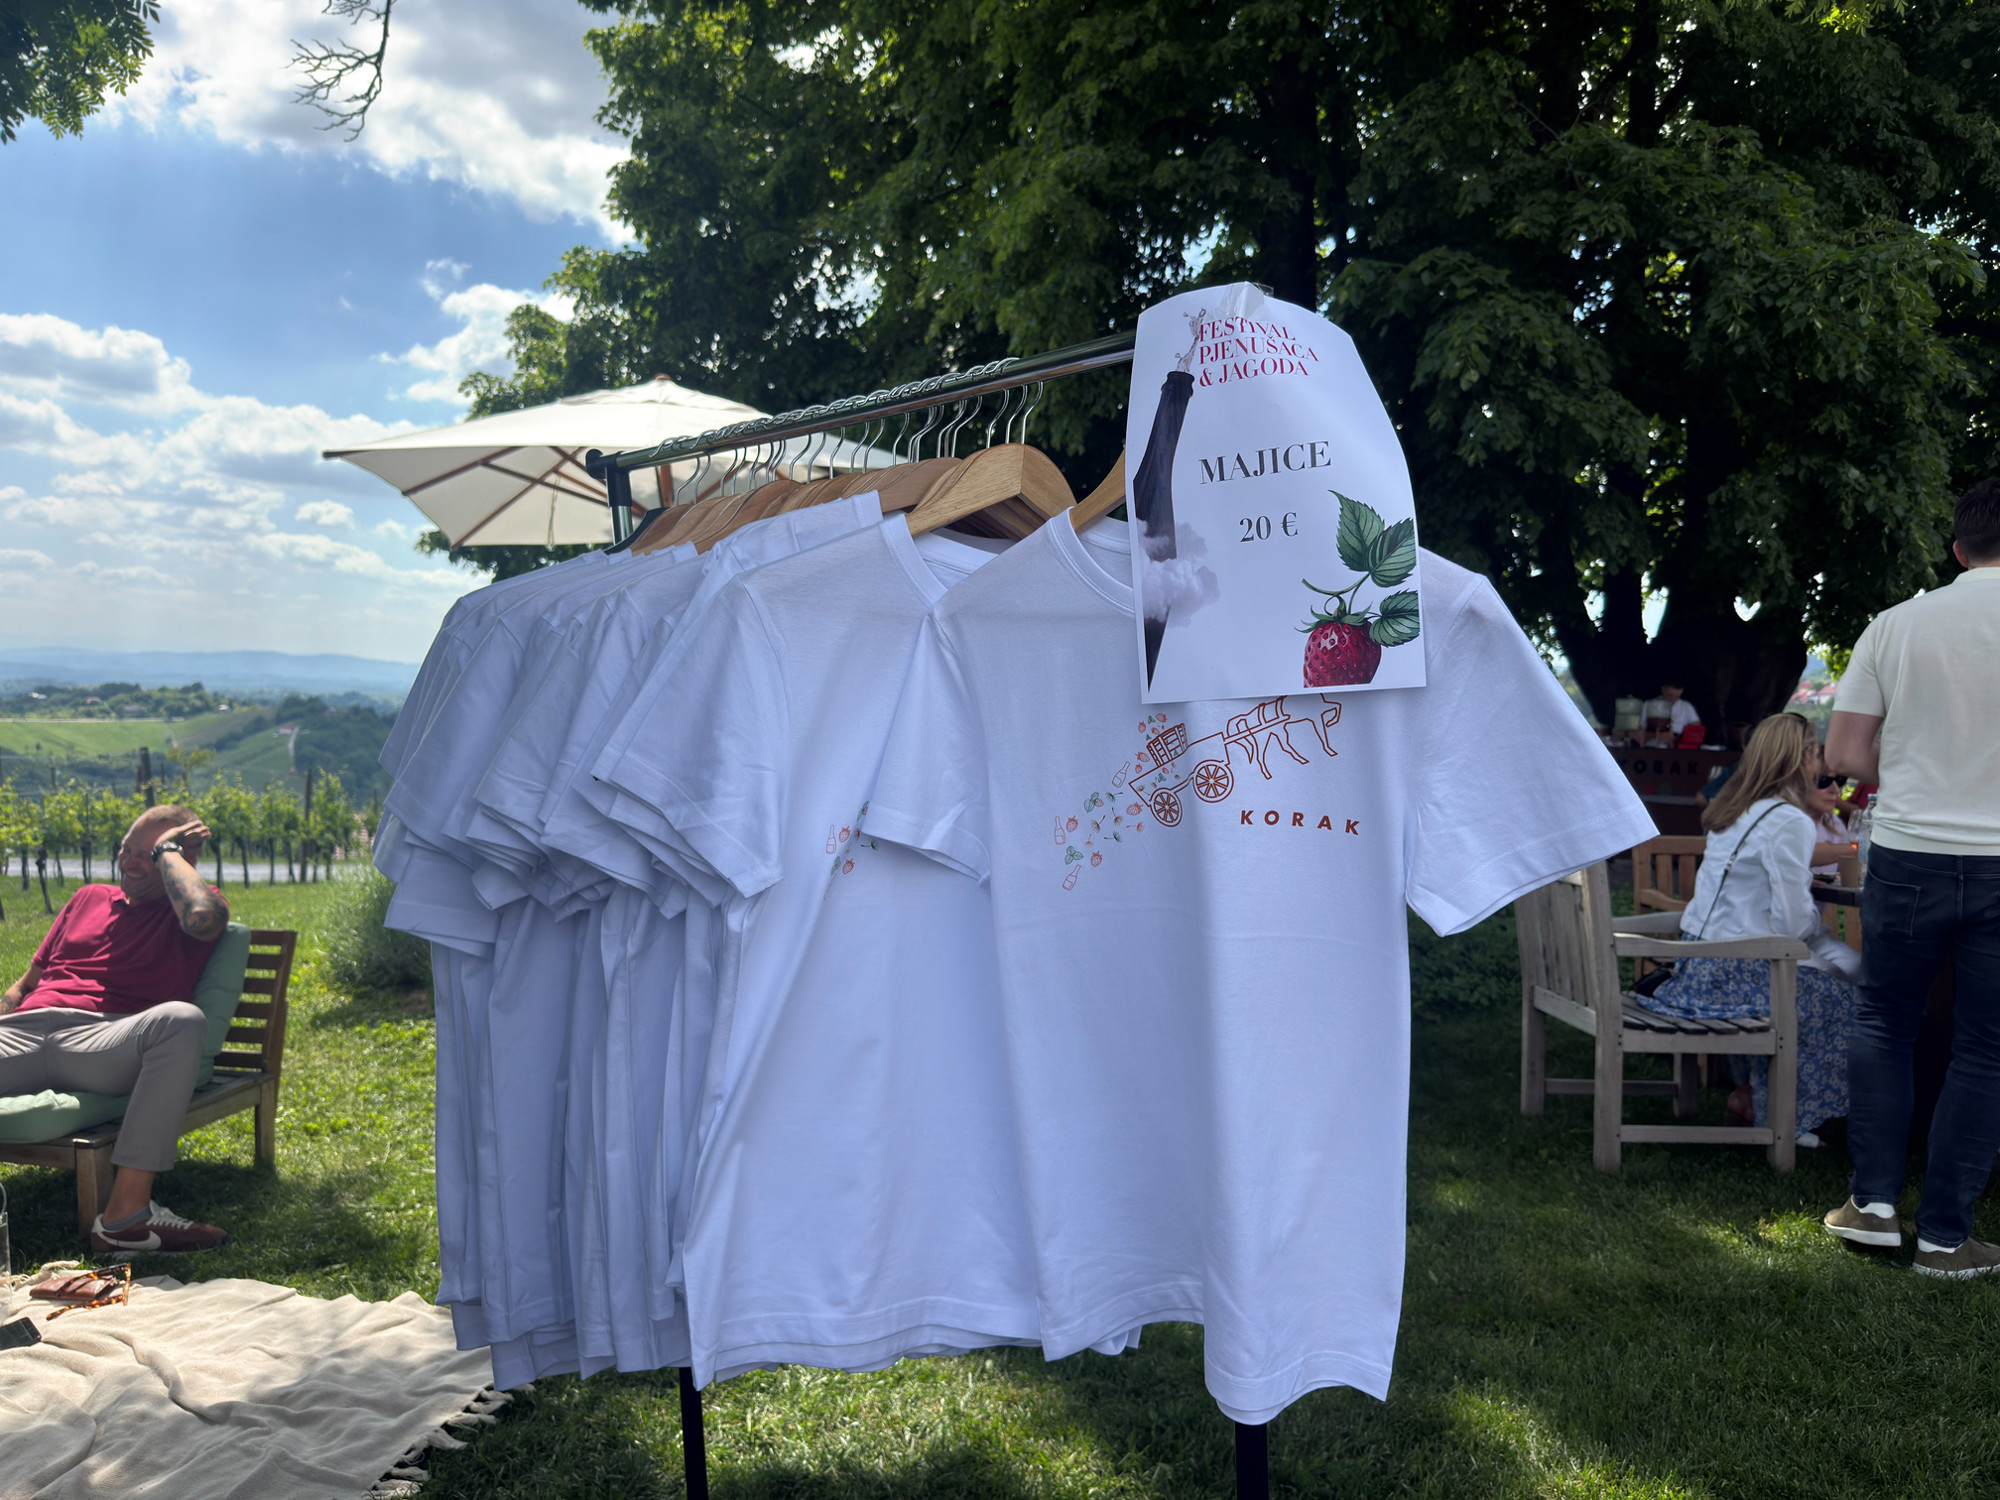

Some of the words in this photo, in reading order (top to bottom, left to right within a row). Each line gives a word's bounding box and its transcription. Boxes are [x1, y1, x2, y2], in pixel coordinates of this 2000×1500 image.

[1199, 316, 1296, 342] FESTIVAL
[1199, 336, 1319, 365] PJENUŠACA
[1199, 368, 1213, 387] &
[1219, 357, 1309, 383] JAGODA
[1199, 441, 1332, 484] MAJICE
[1239, 516, 1272, 543] 20
[1281, 512, 1298, 537] €
[1240, 810, 1361, 836] KORAK
